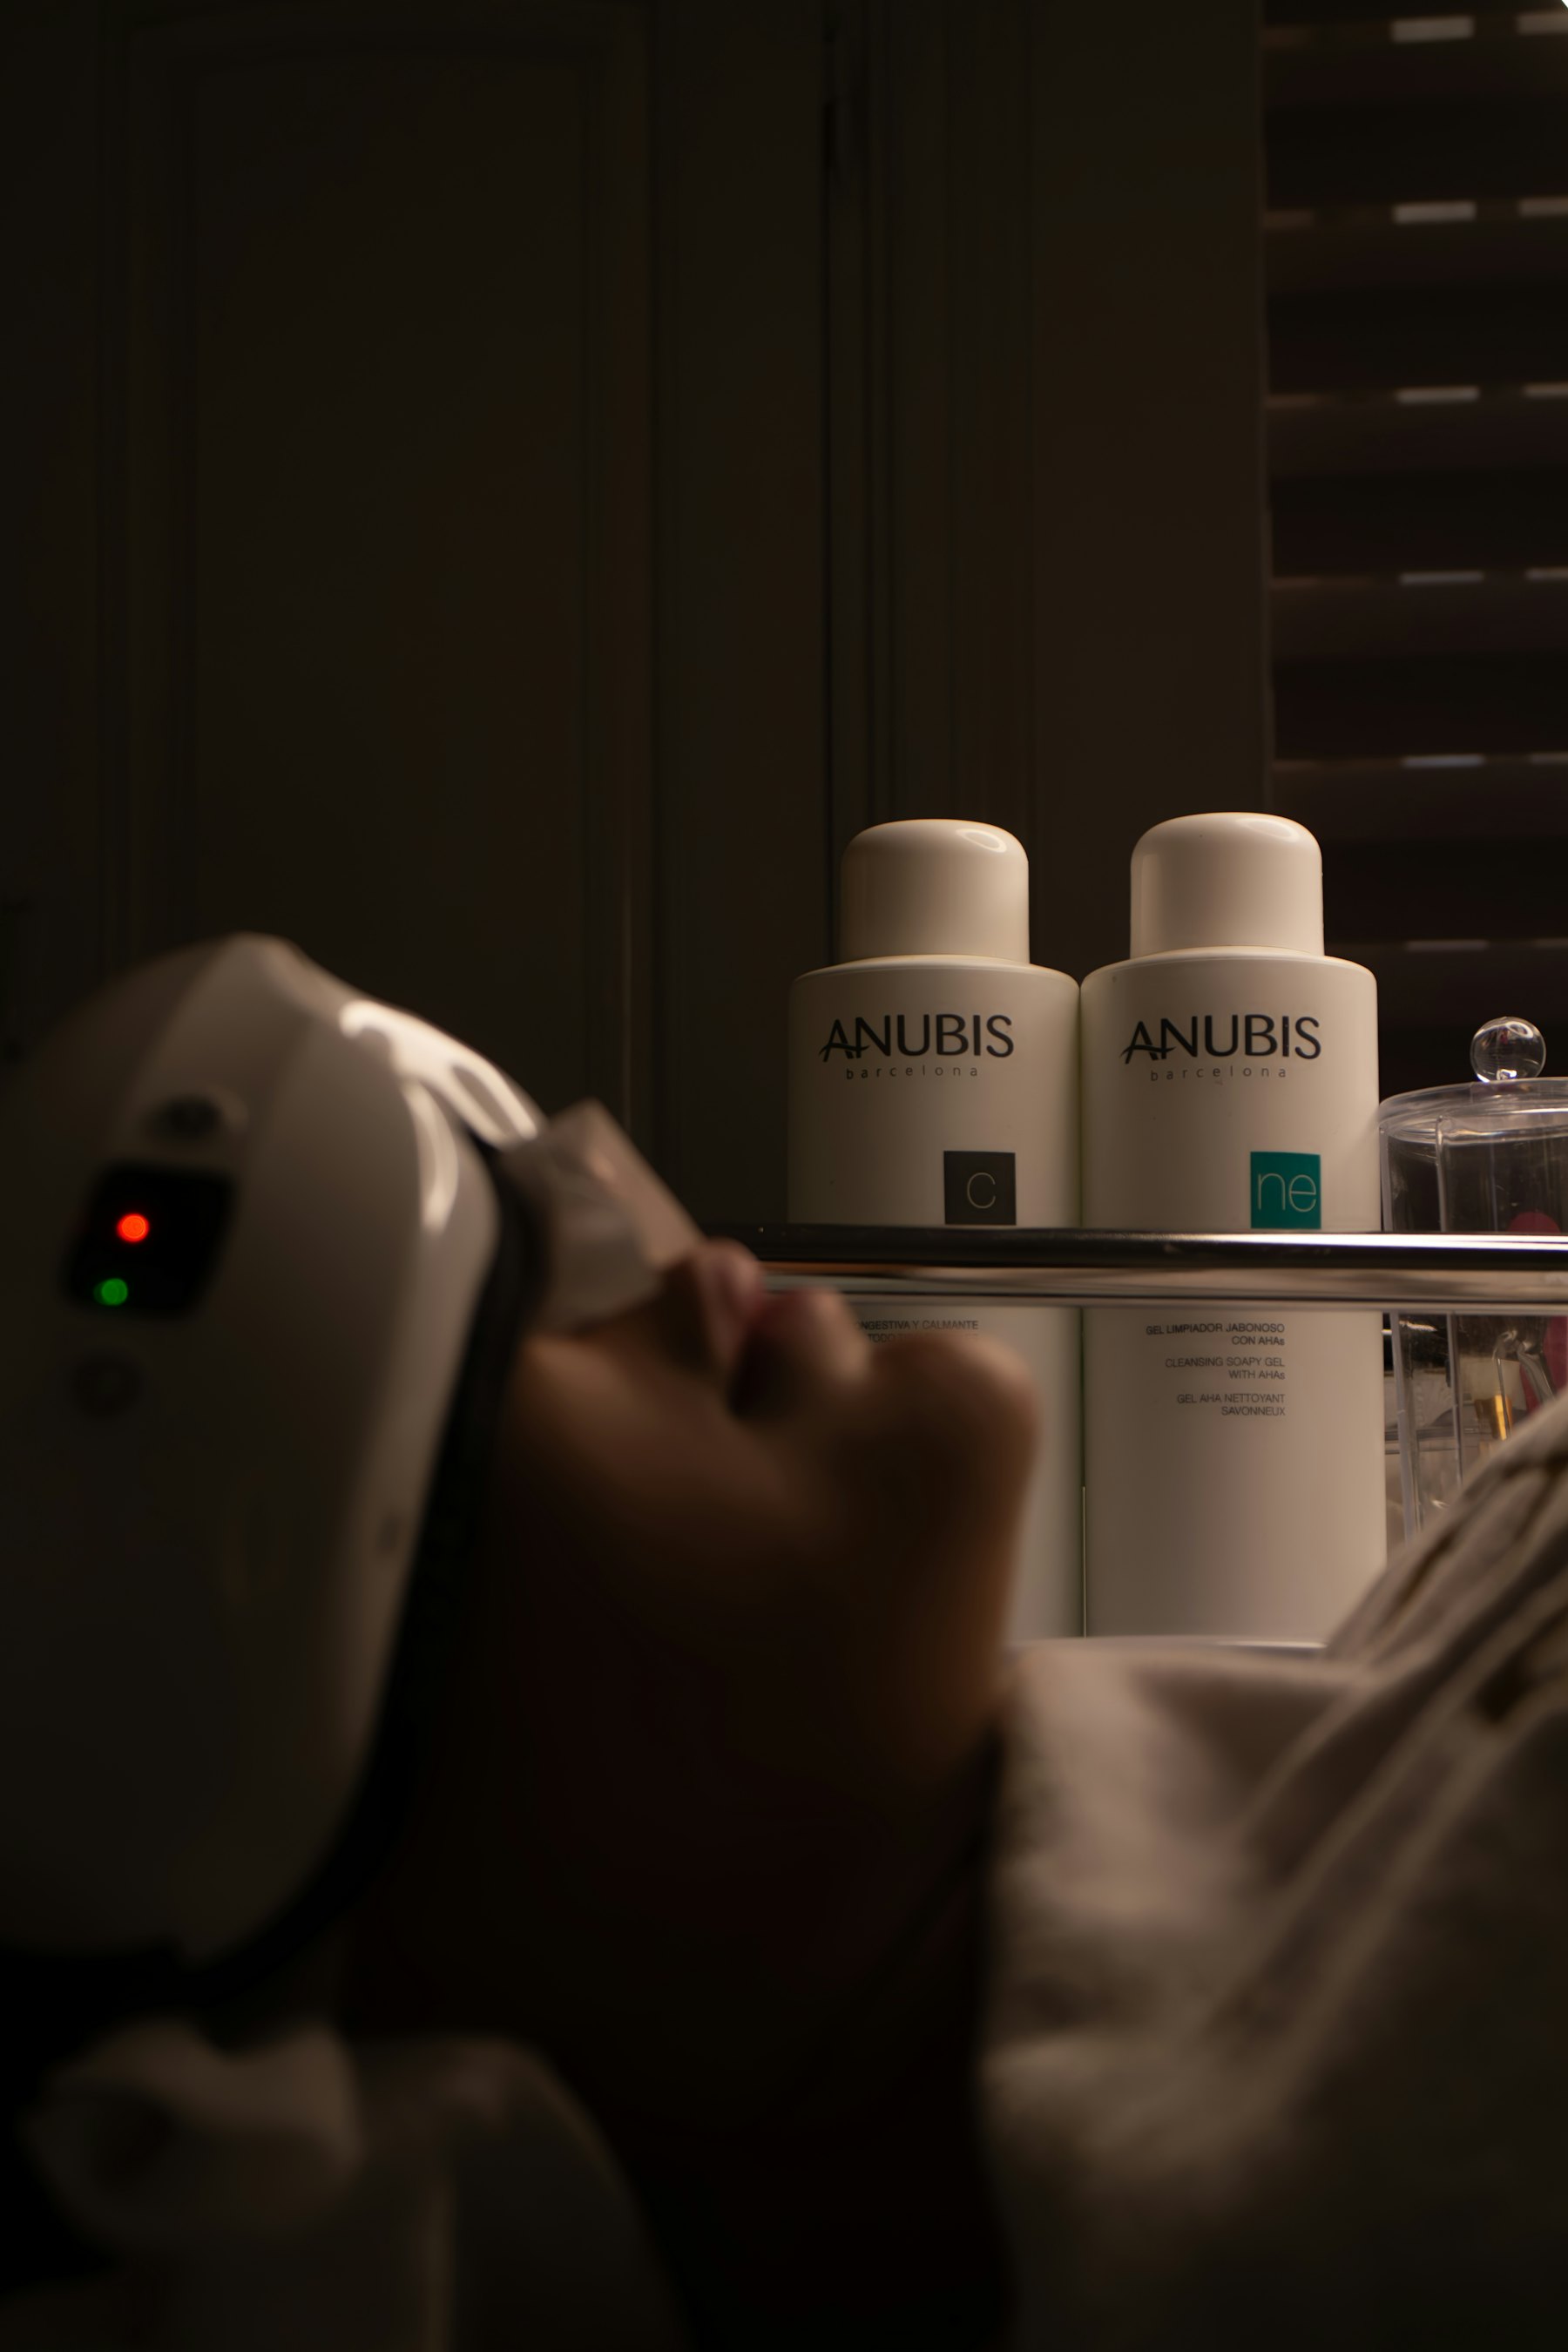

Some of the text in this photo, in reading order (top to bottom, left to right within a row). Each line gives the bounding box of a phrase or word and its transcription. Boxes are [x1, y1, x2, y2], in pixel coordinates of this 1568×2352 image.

[819, 1014, 1014, 1062] ANUBIS
[1119, 1015, 1321, 1064] ANUBIS
[846, 1065, 978, 1079] barcelona
[1151, 1065, 1287, 1081] barcelona
[1258, 1173, 1317, 1213] ne
[857, 1320, 979, 1330] NGESTIVA Y CALMANTE
[1146, 1322, 1286, 1335] GEL LIMPIADOR JABONOSO
[1232, 1335, 1285, 1346] CON AHAs
[1165, 1356, 1285, 1368] CLEANSING SOAPY GEL
[1228, 1369, 1286, 1380] WITH AHAs
[1177, 1393, 1286, 1404] GEL AHA NETTOYANT
[1221, 1406, 1286, 1416] SAVONNEUX
